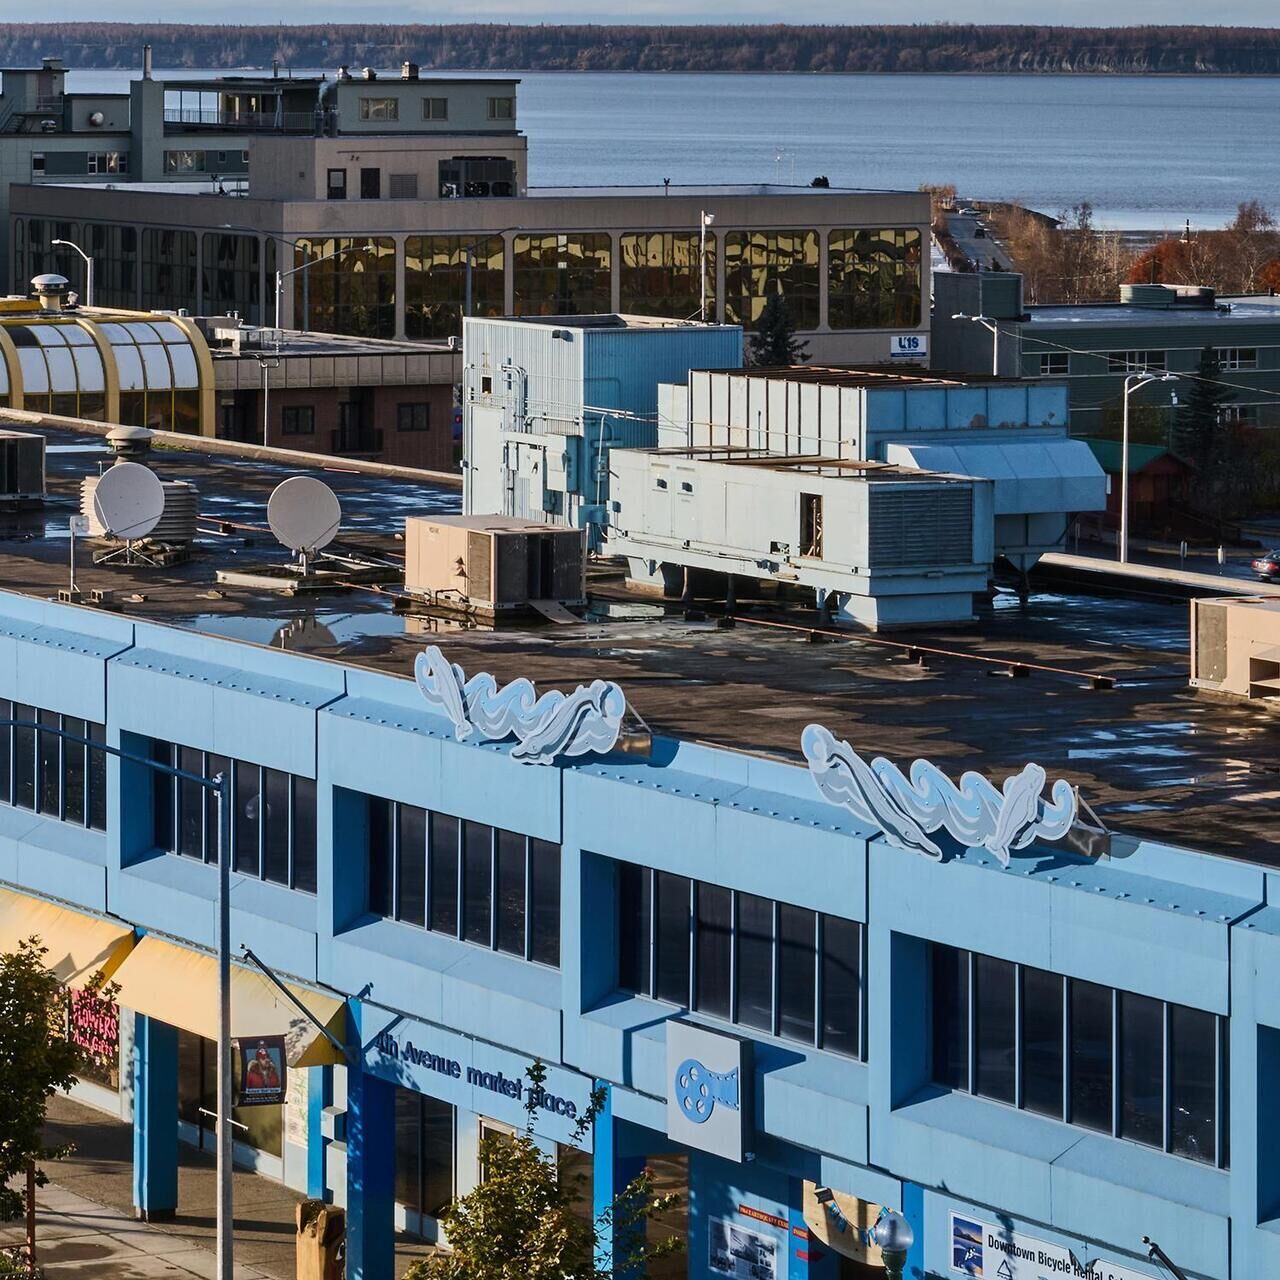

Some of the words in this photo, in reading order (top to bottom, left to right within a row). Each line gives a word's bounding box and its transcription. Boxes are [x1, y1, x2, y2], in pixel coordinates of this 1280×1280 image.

[402, 1040, 462, 1079] Avenue
[466, 1066, 523, 1101] market
[527, 1086, 578, 1120] place
[988, 1234, 1036, 1263] Downtown
[1037, 1252, 1072, 1273] Bicycle
